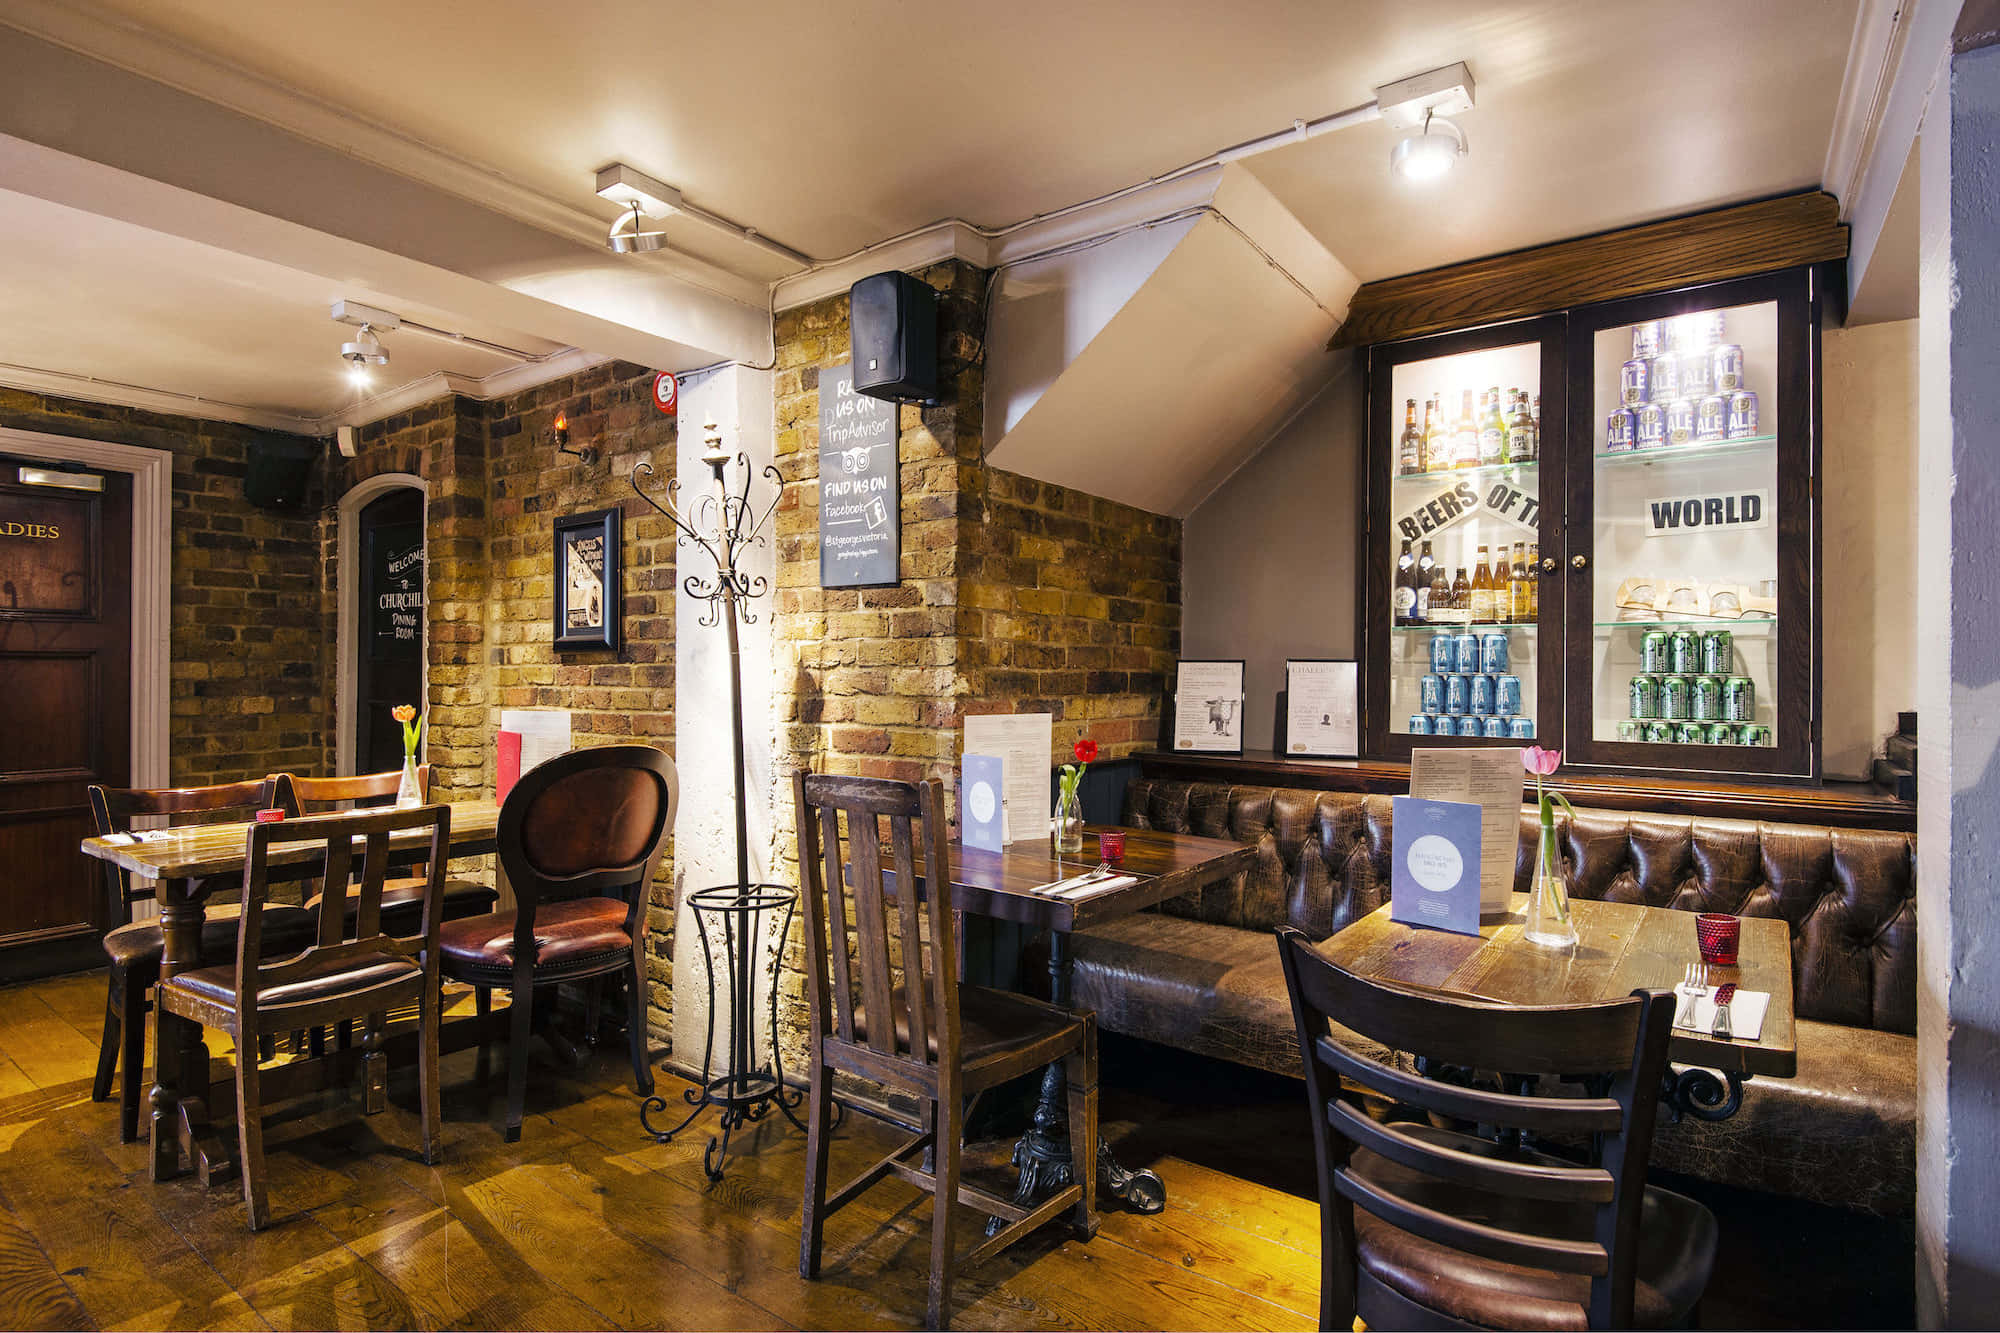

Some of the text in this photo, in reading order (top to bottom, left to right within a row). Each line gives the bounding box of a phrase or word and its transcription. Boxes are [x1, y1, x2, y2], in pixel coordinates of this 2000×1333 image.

[836, 396, 876, 418] US ON
[1608, 426, 1632, 444] ALE
[1638, 422, 1662, 441] ALE
[824, 475, 887, 497] FIND US ON
[825, 500, 865, 517] Facebook
[1486, 484, 1522, 514] OF
[1398, 481, 1479, 542] BEERS
[1651, 495, 1761, 529] WORLD
[388, 548, 424, 573] WELCOME
